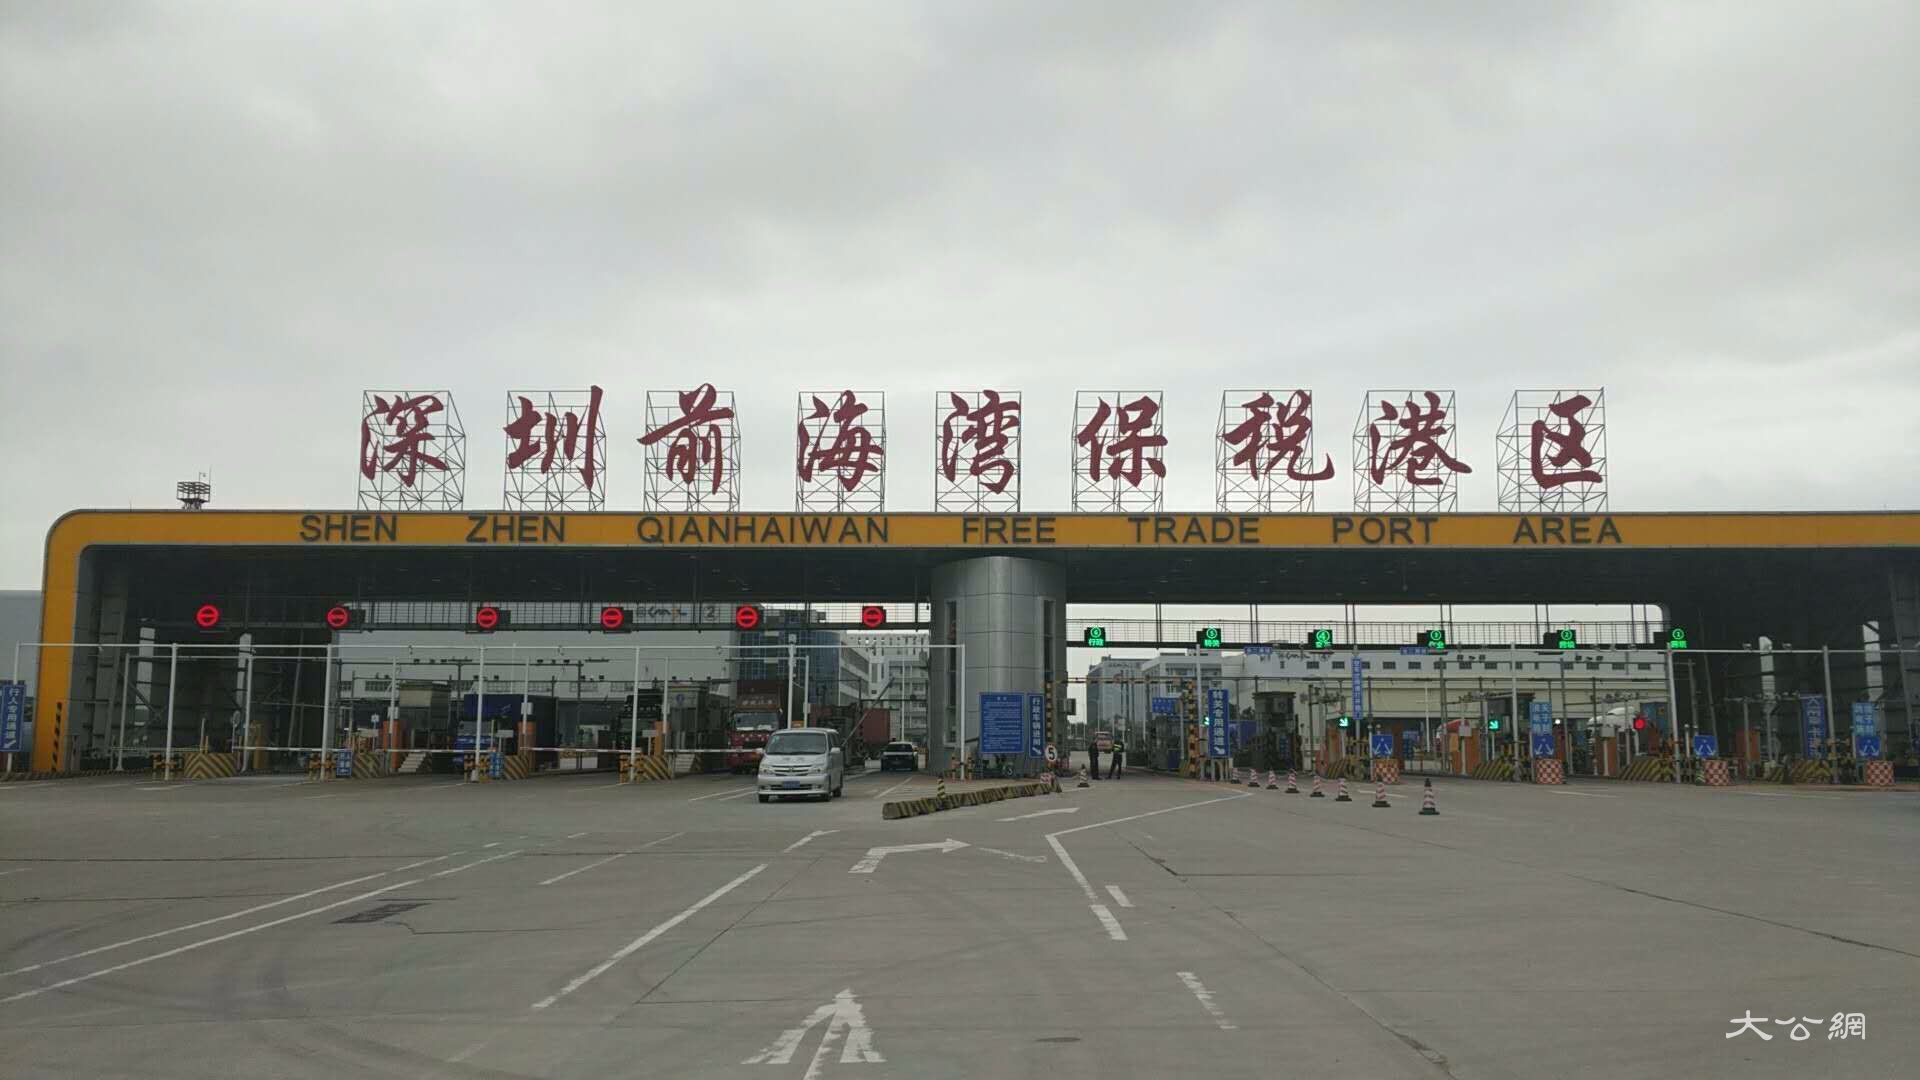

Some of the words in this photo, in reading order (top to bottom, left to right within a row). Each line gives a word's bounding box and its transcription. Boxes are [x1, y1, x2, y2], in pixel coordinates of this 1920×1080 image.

[360, 385, 1603, 494] 深圳前海湾保税港区
[300, 515, 397, 542] SHEN
[466, 515, 564, 543] ZHEN
[637, 516, 888, 544] QIANHAIWAN
[963, 516, 1055, 543] FREE
[1128, 517, 1260, 543] TRADE
[1332, 517, 1437, 543] PORT
[1514, 517, 1621, 543] AREA
[1048, 747, 1055, 760] 5
